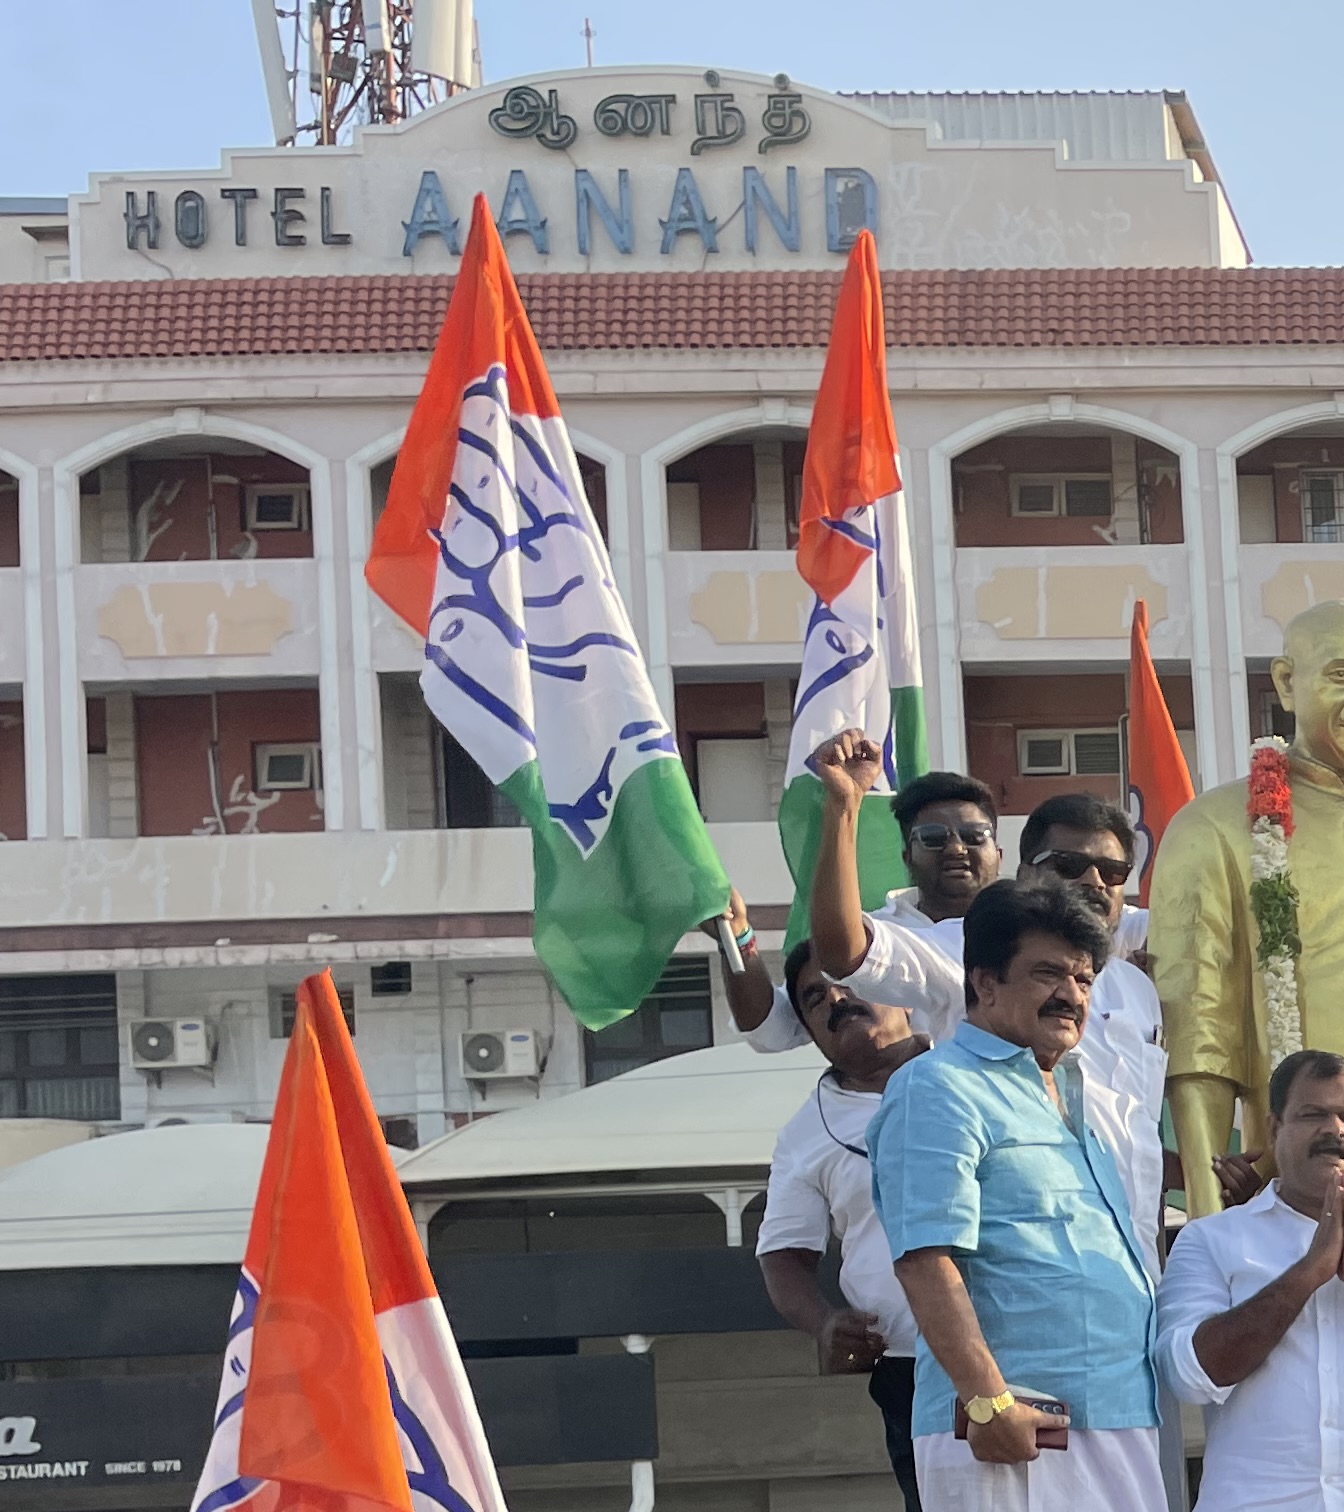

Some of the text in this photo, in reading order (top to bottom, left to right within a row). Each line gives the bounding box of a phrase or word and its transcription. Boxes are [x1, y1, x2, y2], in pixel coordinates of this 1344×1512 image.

[488, 69, 811, 156] ஆனந்த்
[124, 186, 352, 250] HOTEL
[402, 165, 879, 257] AANAND
